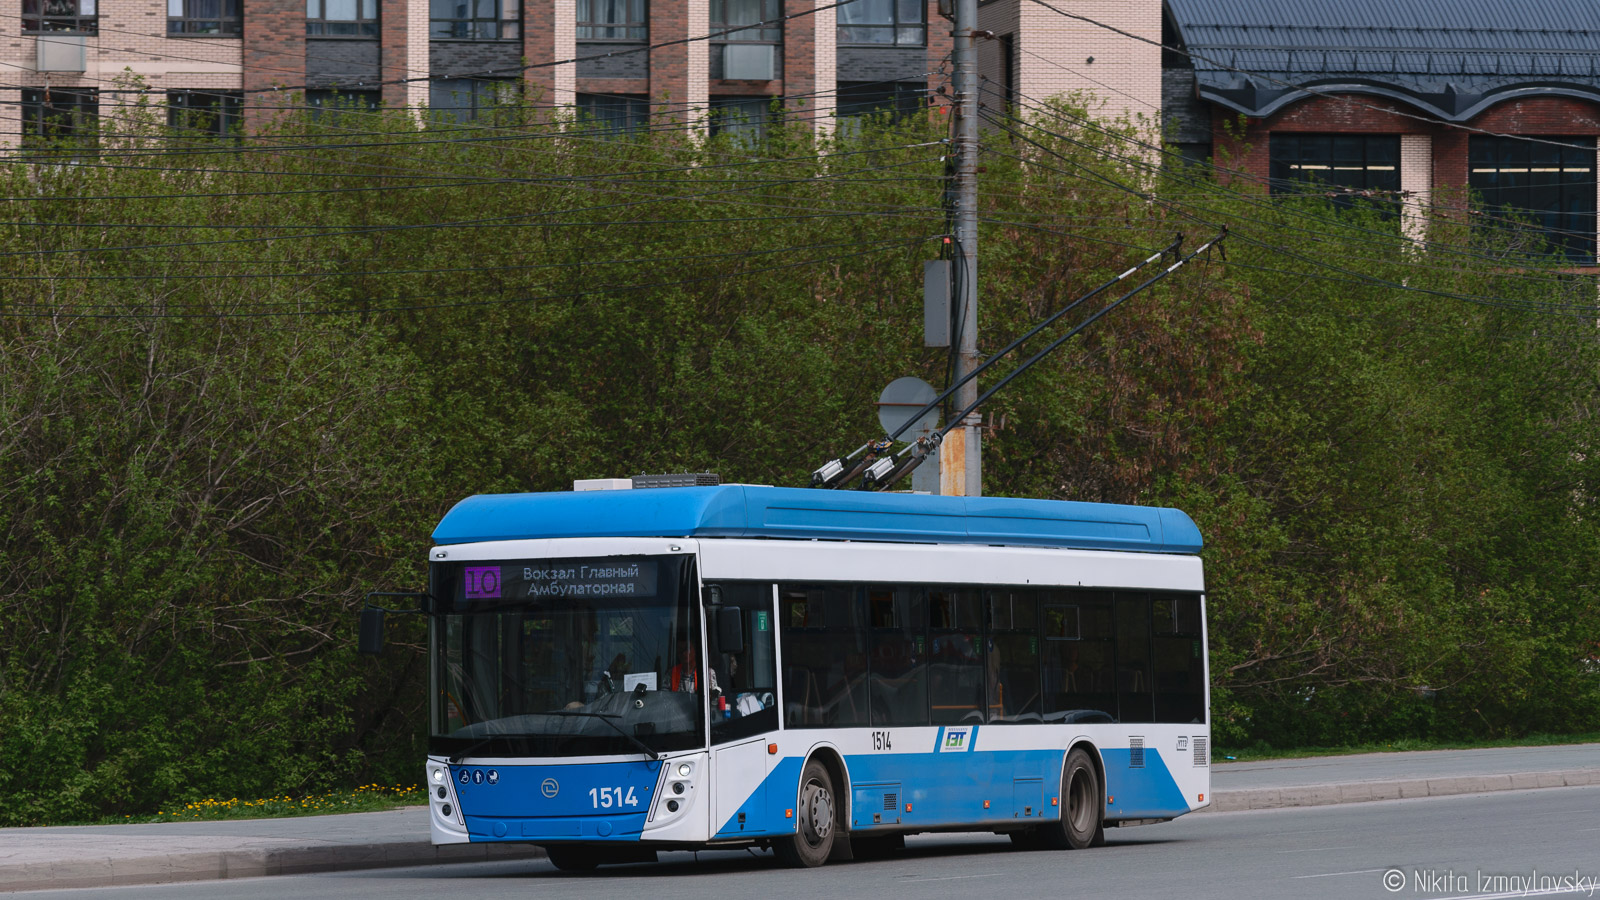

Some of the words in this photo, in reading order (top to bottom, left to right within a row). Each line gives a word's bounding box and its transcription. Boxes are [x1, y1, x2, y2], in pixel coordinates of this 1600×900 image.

[523, 567, 575, 580] Вокзал
[580, 564, 639, 579] Главный
[466, 570, 498, 595] 10
[528, 582, 634, 596] Амбулаторная
[871, 731, 891, 750] 1514
[588, 786, 638, 808] 1514
